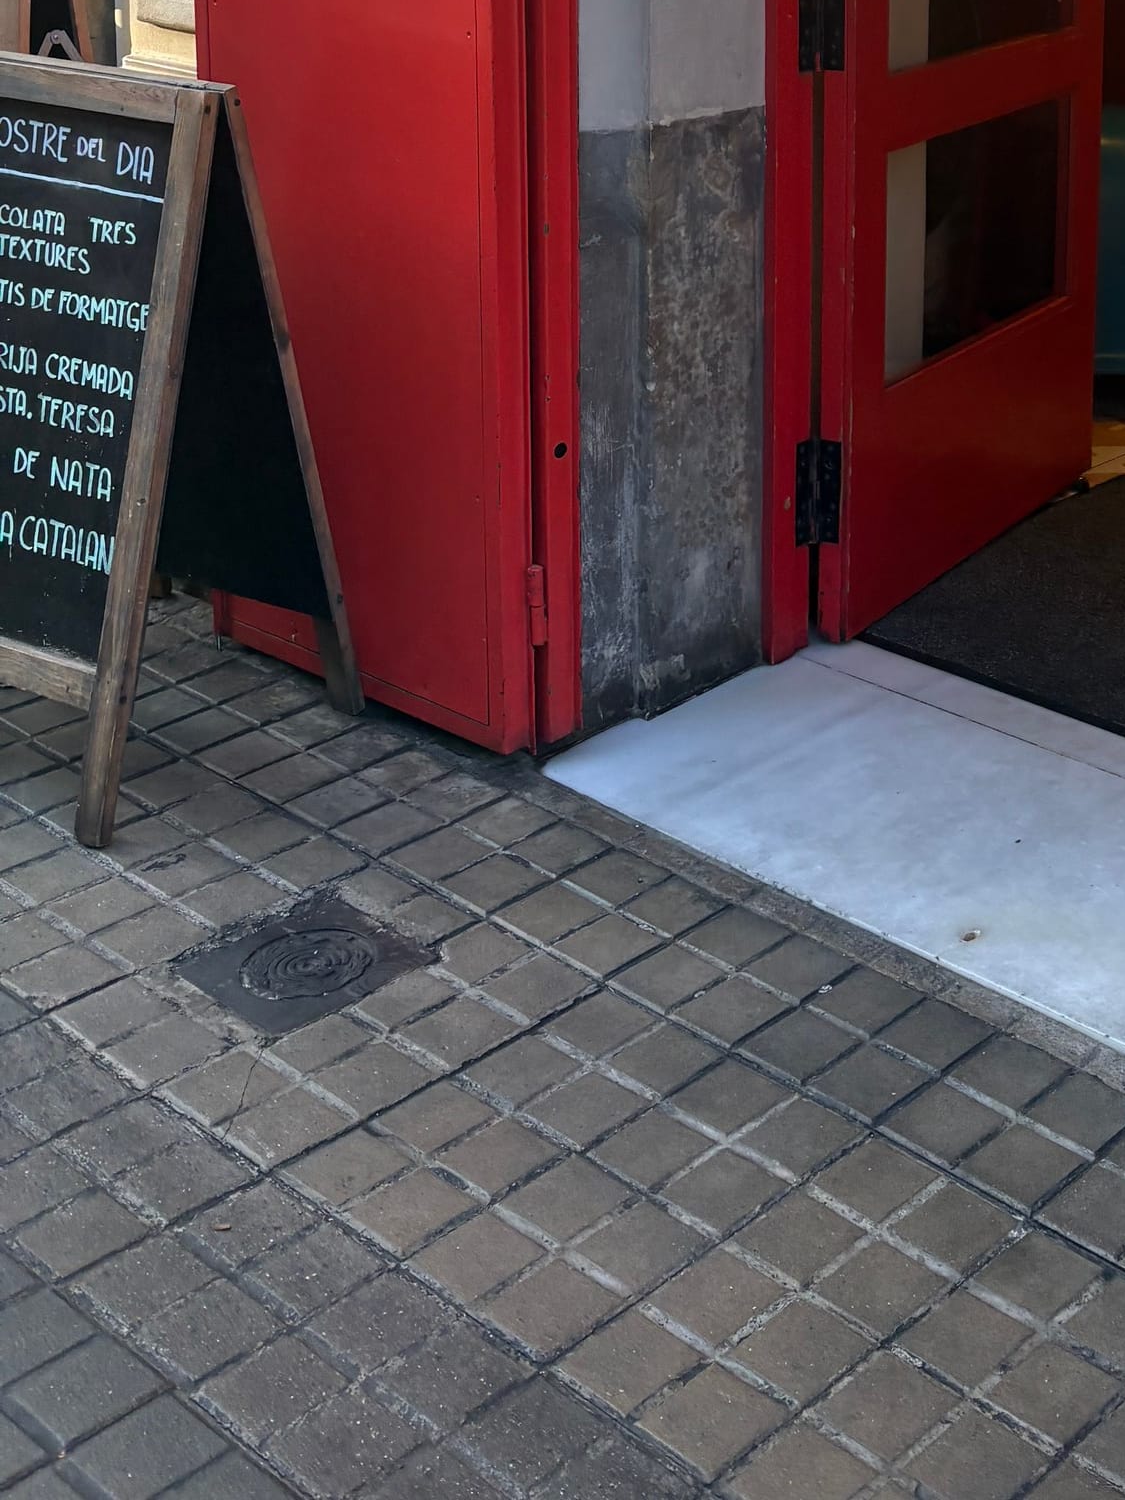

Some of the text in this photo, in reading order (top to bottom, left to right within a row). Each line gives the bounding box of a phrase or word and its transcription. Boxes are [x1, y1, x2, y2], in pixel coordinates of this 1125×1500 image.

[76, 136, 106, 162] DEL
[116, 141, 154, 184] DIA
[0, 233, 91, 274] TEXTURES
[90, 217, 137, 245] TRES
[31, 288, 55, 312] DE
[58, 291, 150, 332] FORMATGE
[45, 353, 134, 401] CREMADA
[38, 392, 114, 438] TERESA
[13, 447, 112, 502] DE NATA
[19, 515, 115, 575] CATALAN
